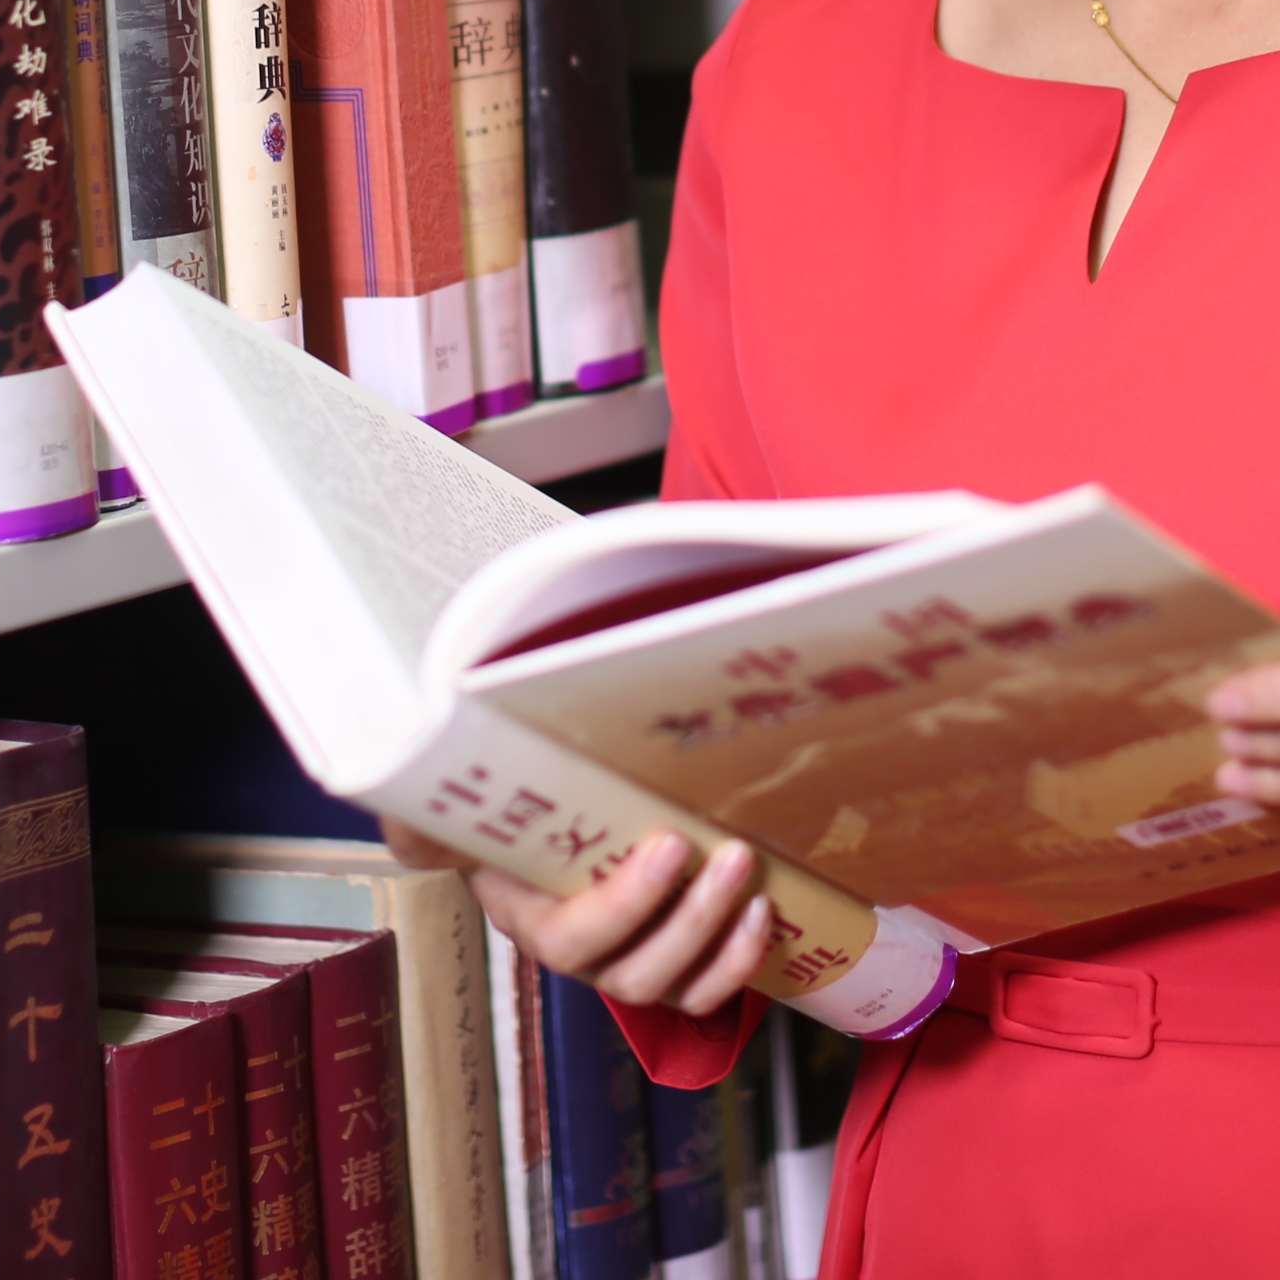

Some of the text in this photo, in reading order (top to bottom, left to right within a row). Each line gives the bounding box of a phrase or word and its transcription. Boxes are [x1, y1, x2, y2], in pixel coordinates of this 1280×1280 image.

[334, 995, 394, 1061] 二十
[3, 911, 73, 1261] 二十五史
[245, 1035, 306, 1102] 二十
[150, 1082, 225, 1150] 二十
[249, 1113, 312, 1183] 六史
[155, 1160, 231, 1234] 六史
